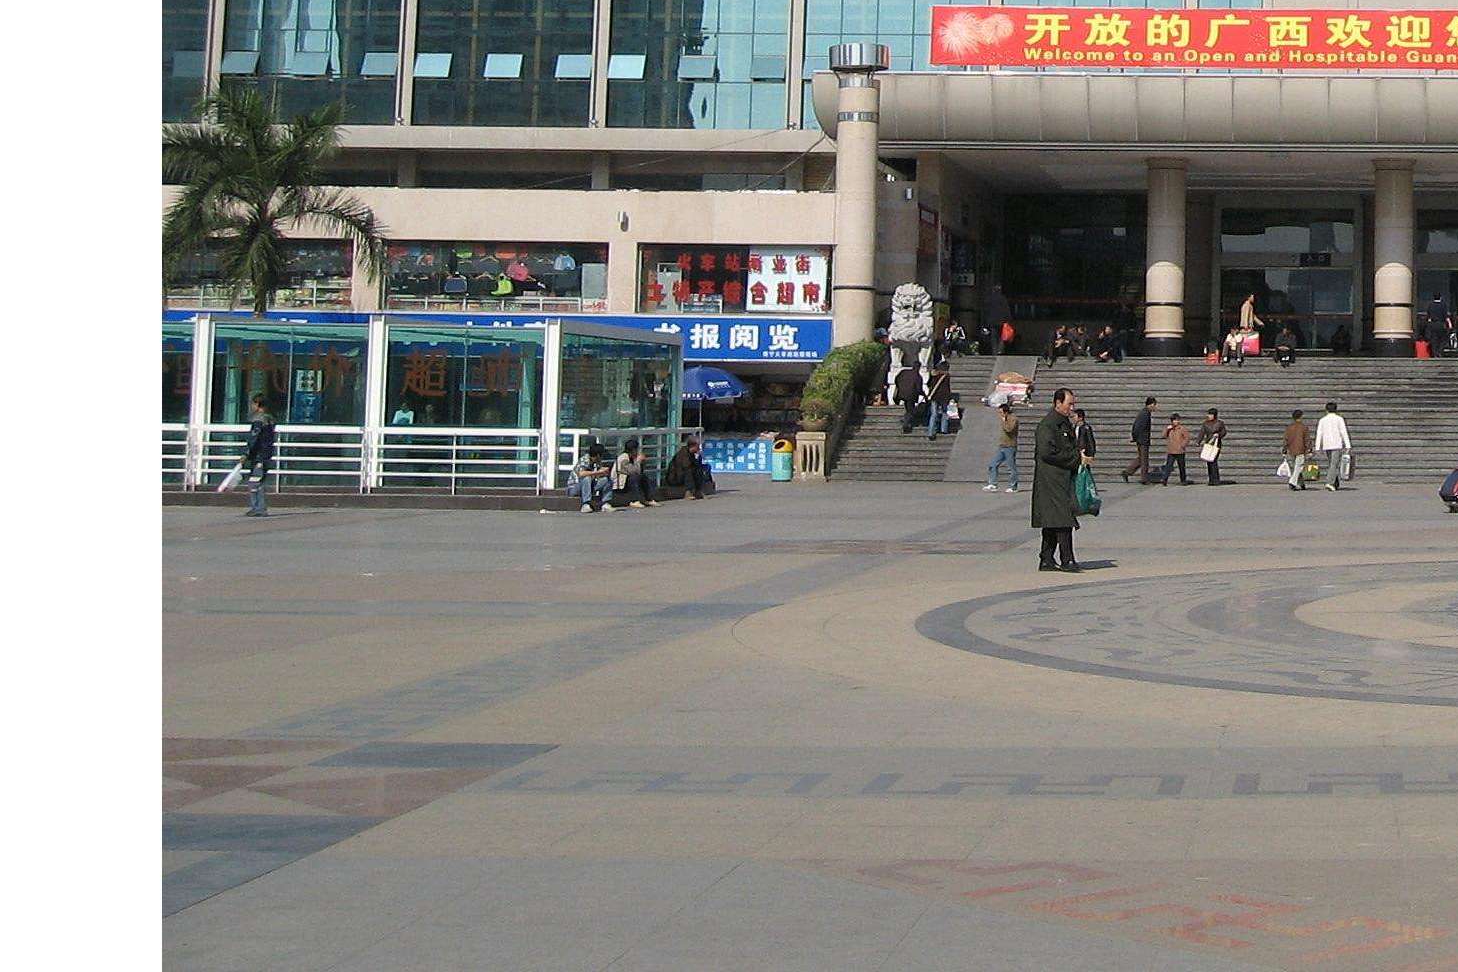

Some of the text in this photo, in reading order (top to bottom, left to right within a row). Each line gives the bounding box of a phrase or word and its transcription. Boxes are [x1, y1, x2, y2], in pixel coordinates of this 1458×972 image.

[1023, 47, 1116, 62] Welcome
[1123, 49, 1144, 62] to
[1152, 51, 1175, 62] an
[1184, 49, 1236, 64] Open
[1244, 50, 1282, 63] and
[1289, 50, 1398, 65] Hospitable
